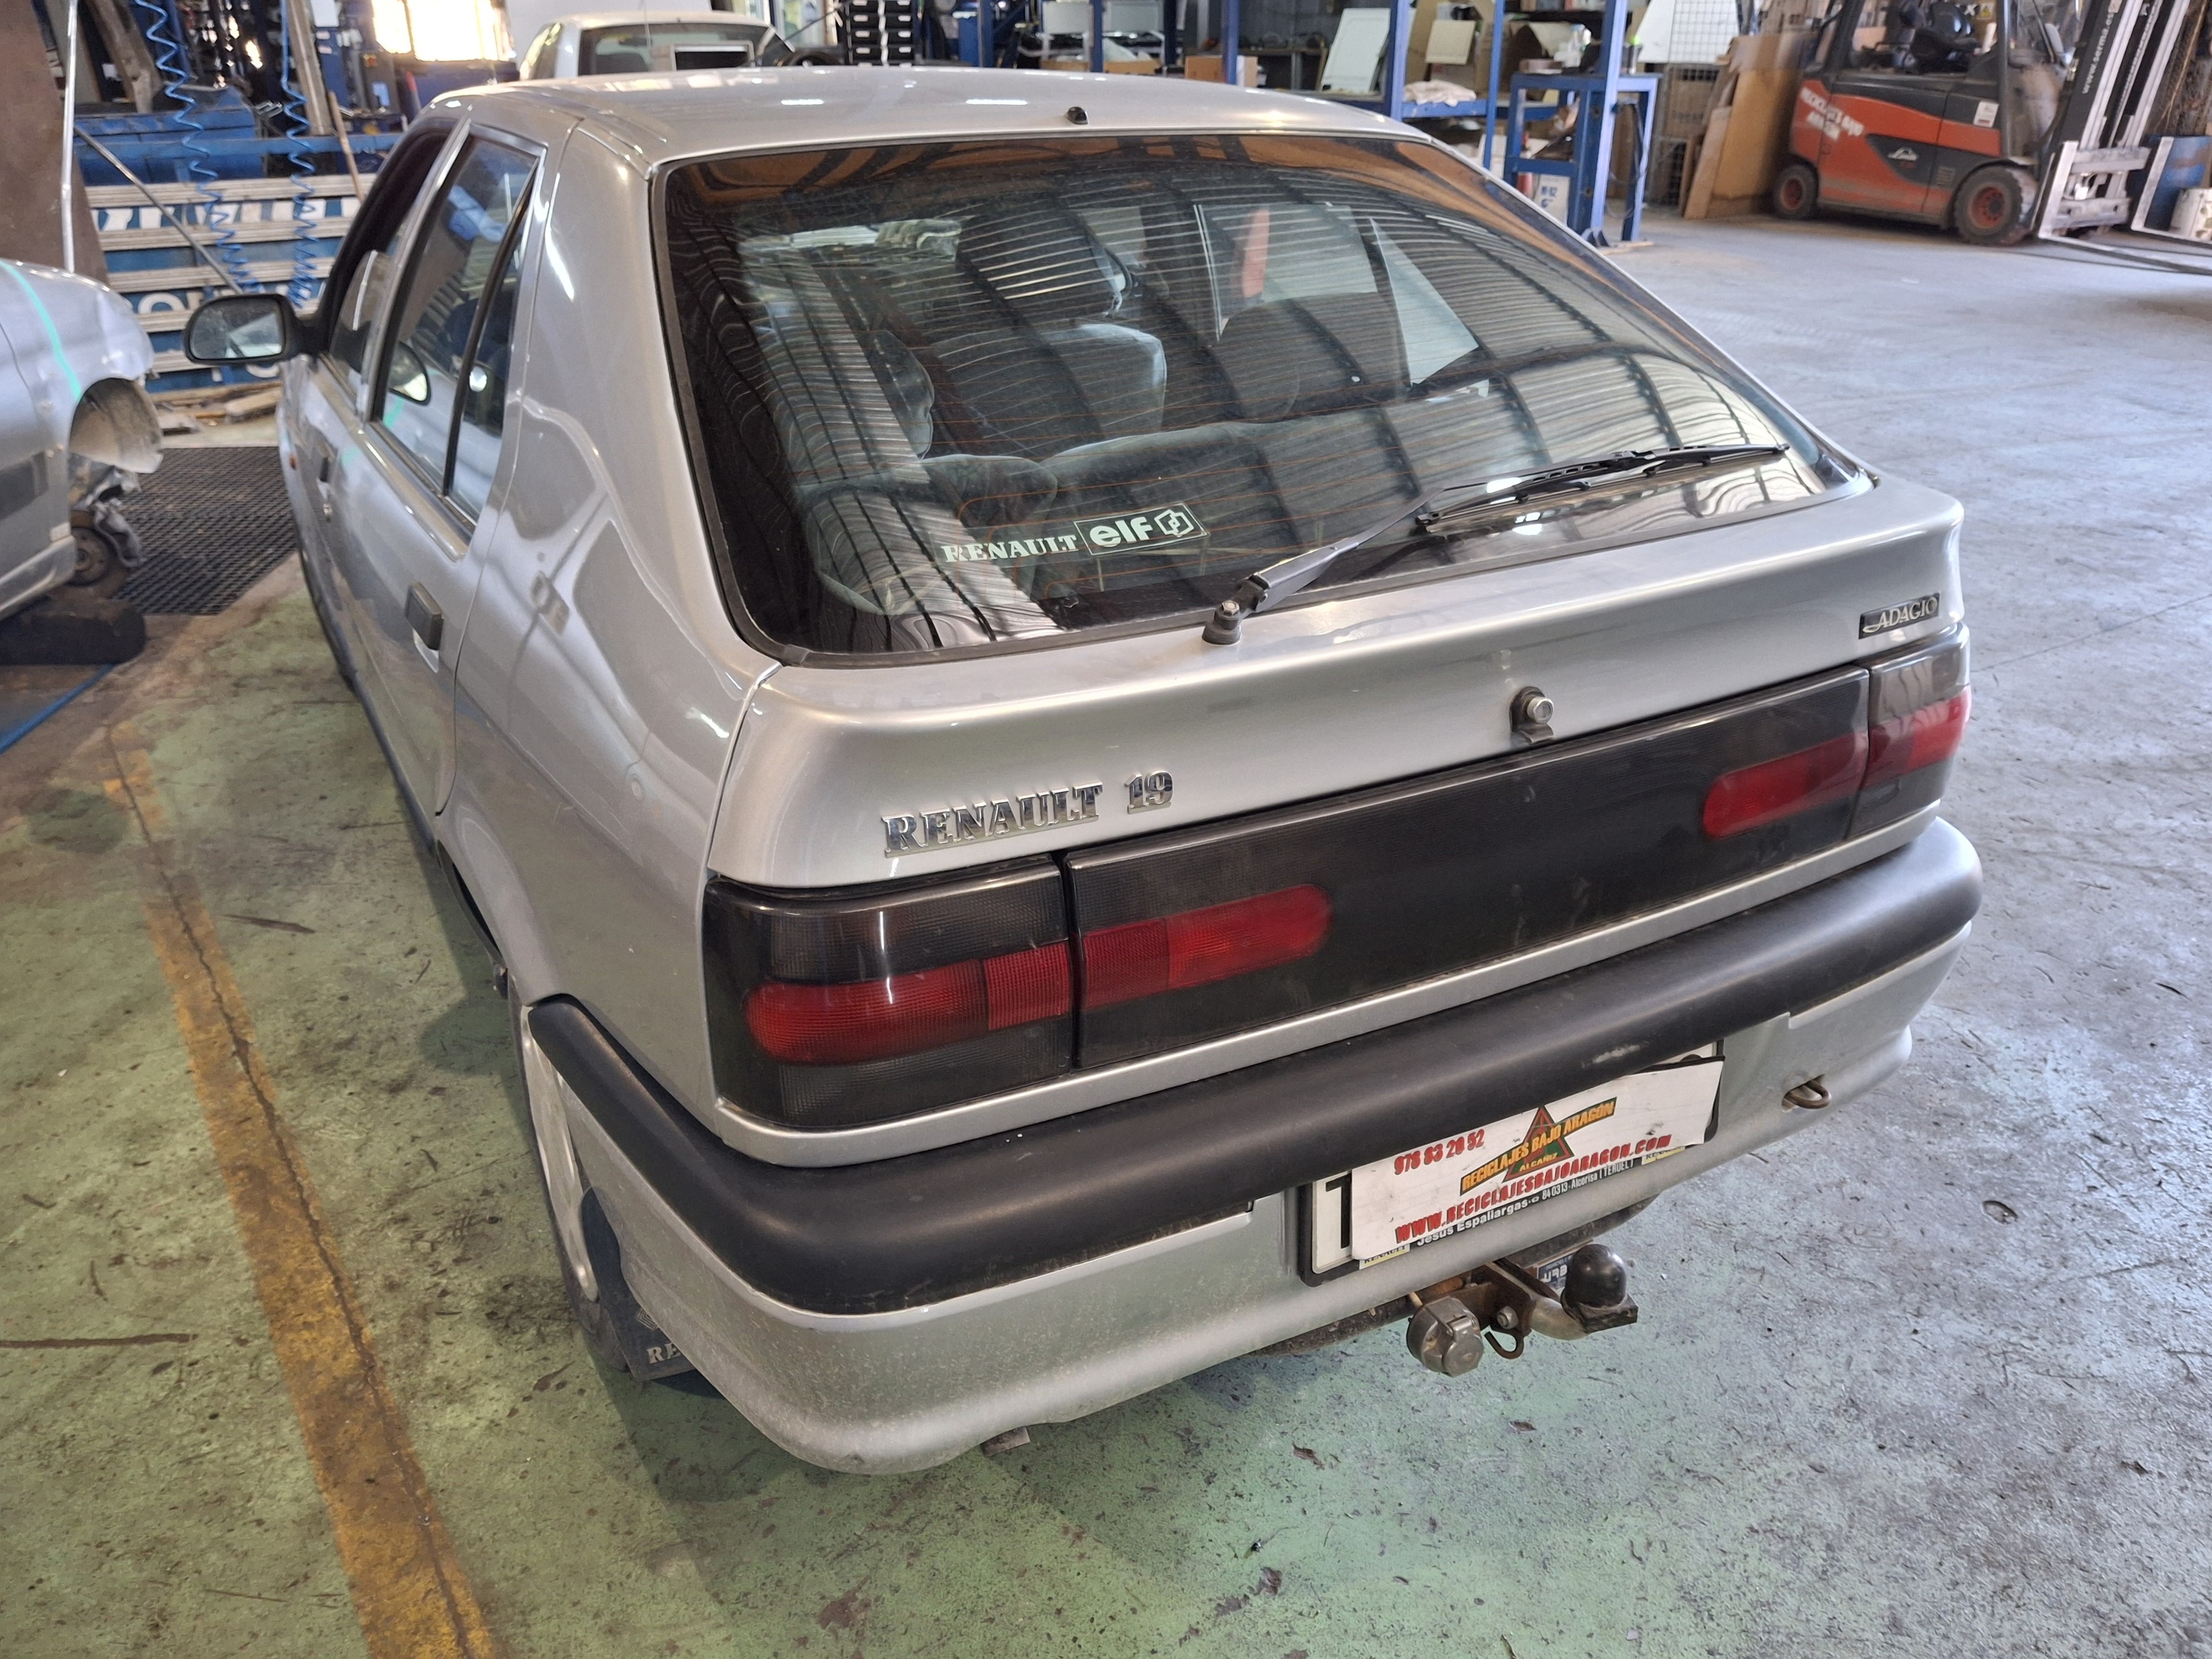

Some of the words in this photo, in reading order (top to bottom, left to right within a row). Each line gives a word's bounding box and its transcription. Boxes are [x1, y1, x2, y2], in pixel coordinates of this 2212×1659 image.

[940, 533, 1080, 563] RENAULT
[1089, 516, 1154, 548] elf
[1862, 596, 1938, 633] ADAGIO
[881, 781, 1104, 858] RENAULT
[1124, 770, 1174, 815] 19
[1394, 1150, 1421, 1176] 978
[1424, 1143, 1444, 1165] 83
[1446, 1136, 1465, 1159] 20
[1467, 1128, 1485, 1151] 52
[1461, 1141, 1530, 1192] RECICLAJES
[1531, 1124, 1562, 1153] BAJO
